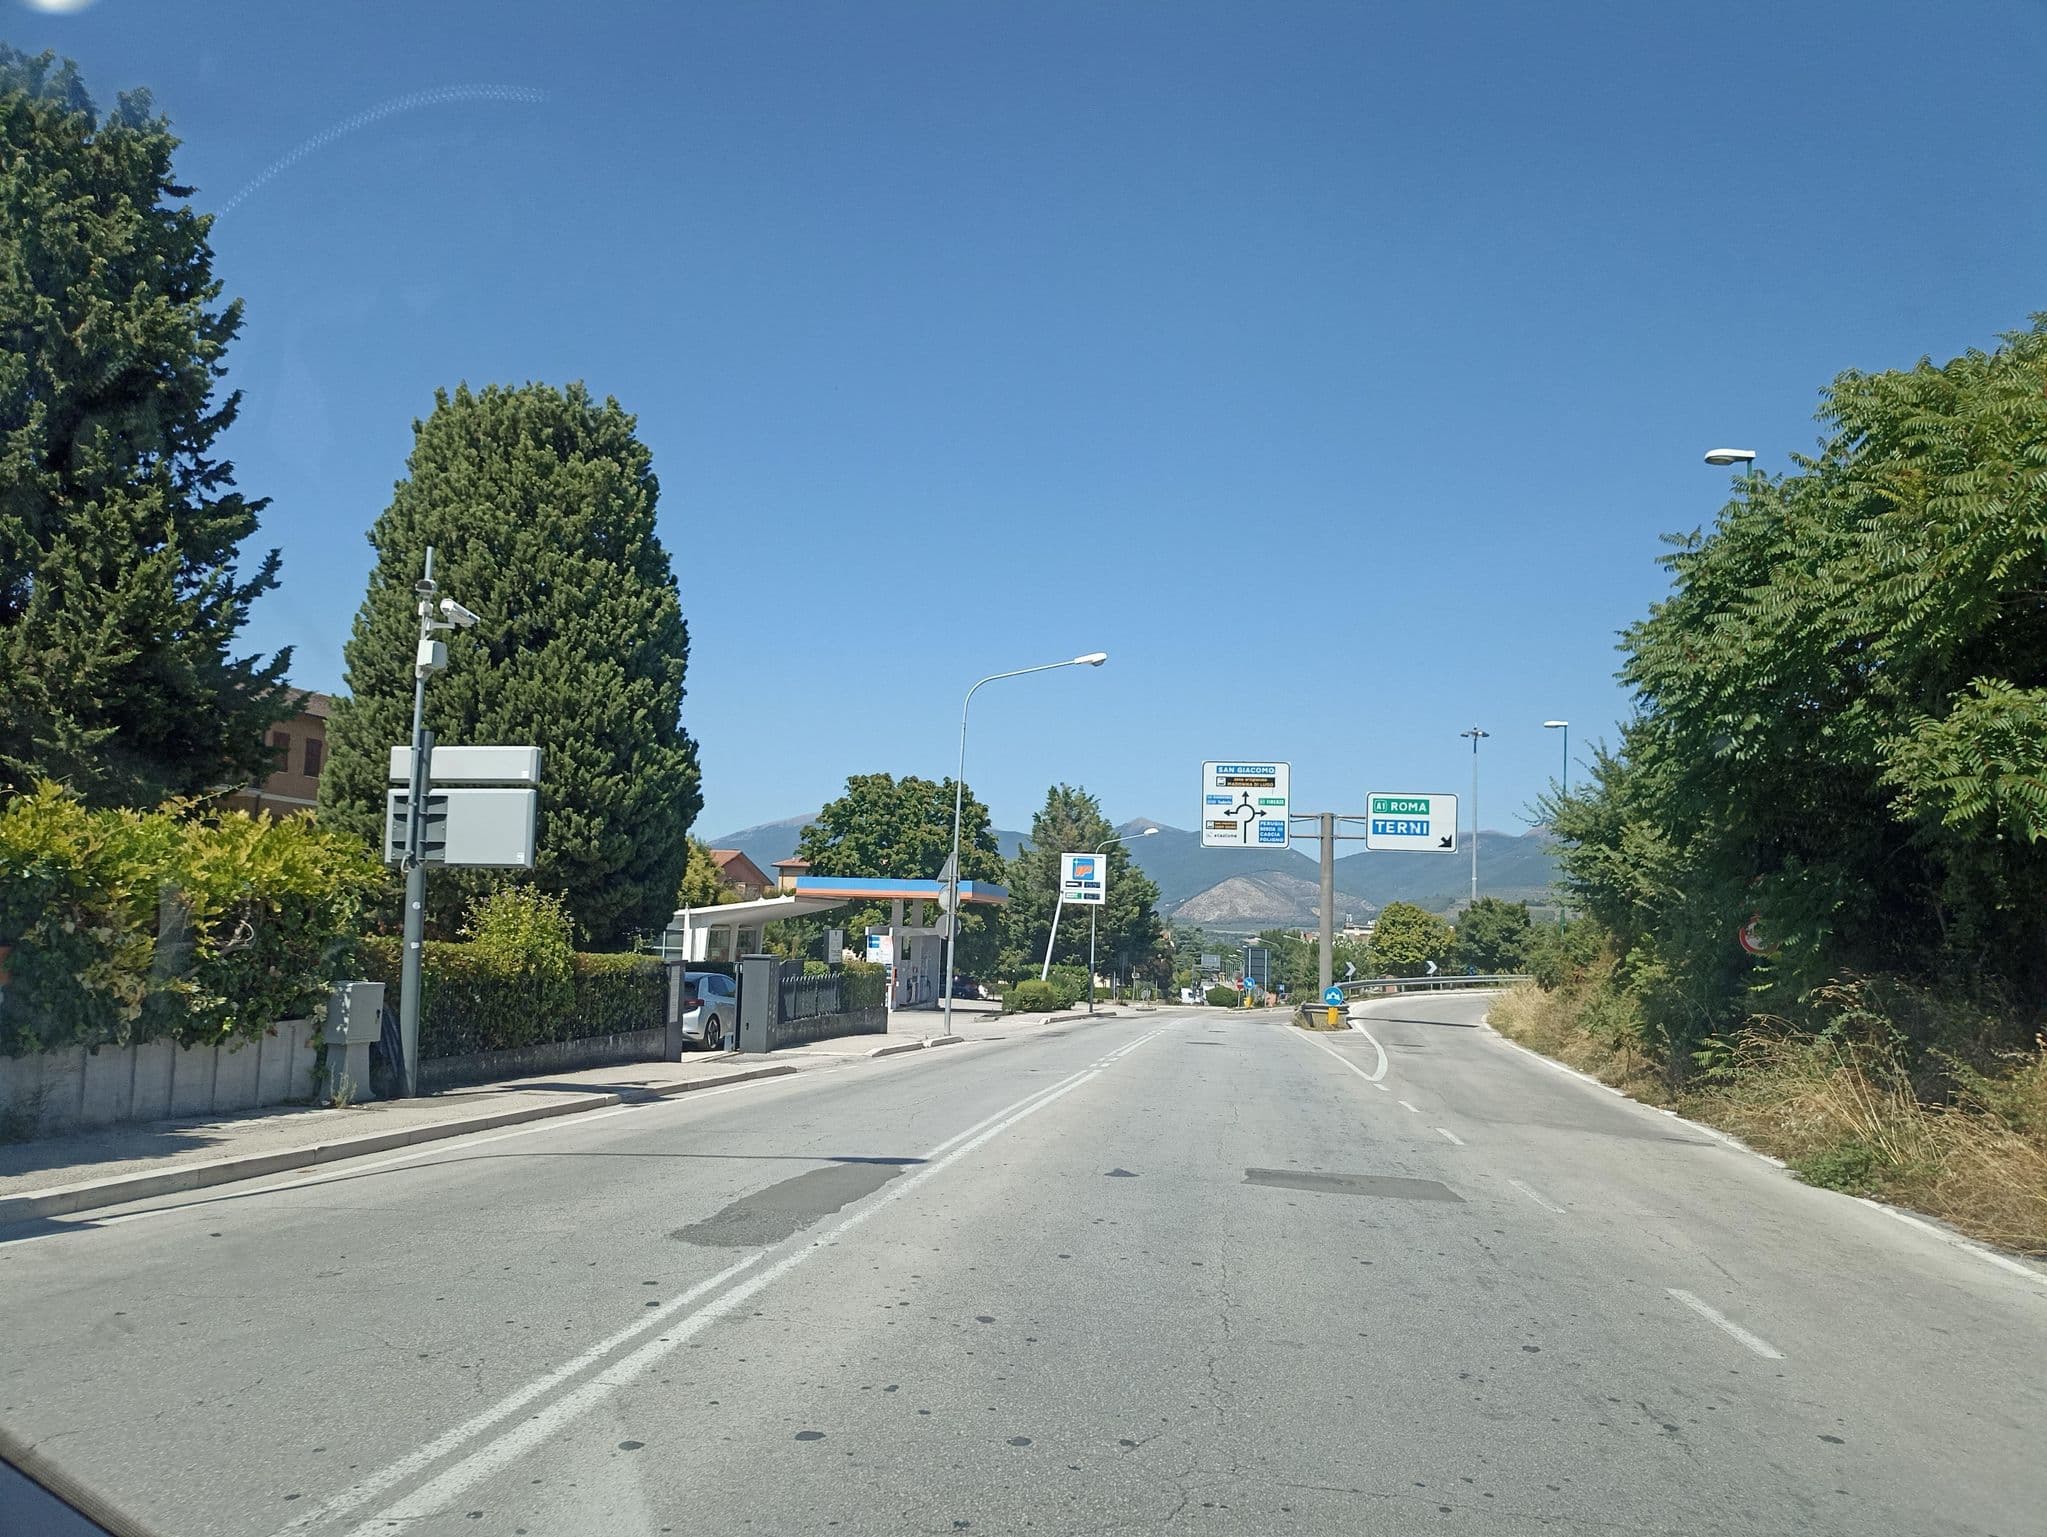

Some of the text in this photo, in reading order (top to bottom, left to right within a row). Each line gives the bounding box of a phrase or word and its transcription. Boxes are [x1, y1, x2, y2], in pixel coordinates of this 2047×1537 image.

[1237, 766, 1275, 774] GIACOMO
[1391, 802, 1427, 812] ROMA
[1375, 821, 1428, 834] TERNI
